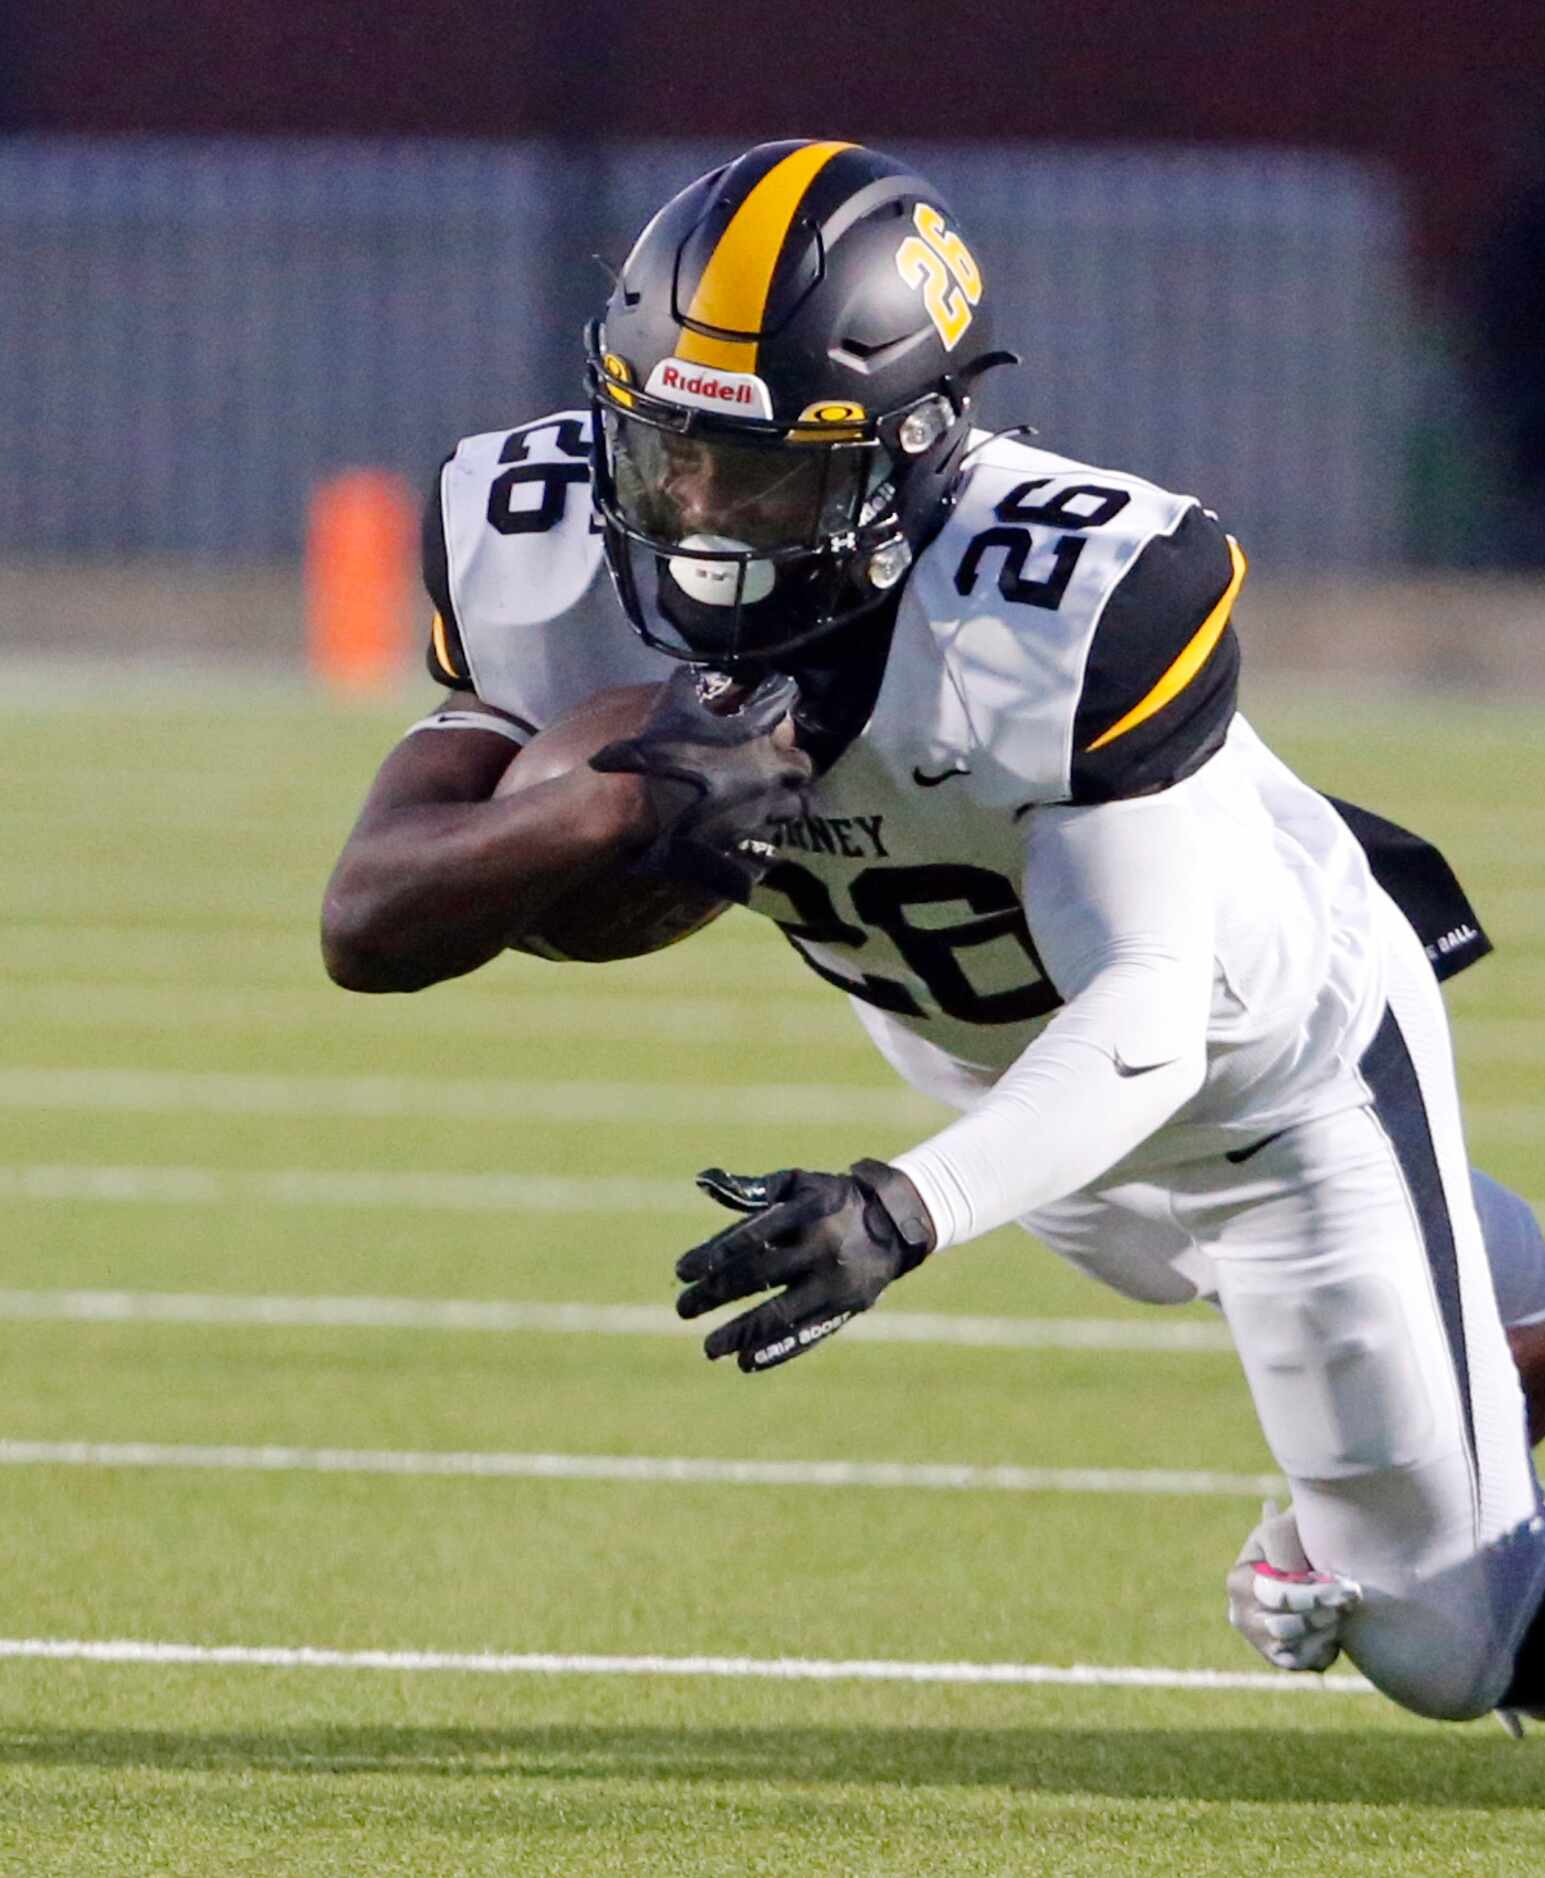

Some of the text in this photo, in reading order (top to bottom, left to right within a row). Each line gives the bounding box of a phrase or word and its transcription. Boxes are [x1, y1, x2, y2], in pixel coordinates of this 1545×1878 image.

[896, 203, 983, 352] 26
[662, 366, 752, 404] Riddell
[487, 418, 592, 536] 26
[953, 477, 1132, 611] 26
[756, 861, 1065, 1025] 26
[754, 1311, 852, 1364] GRIP BOOST
